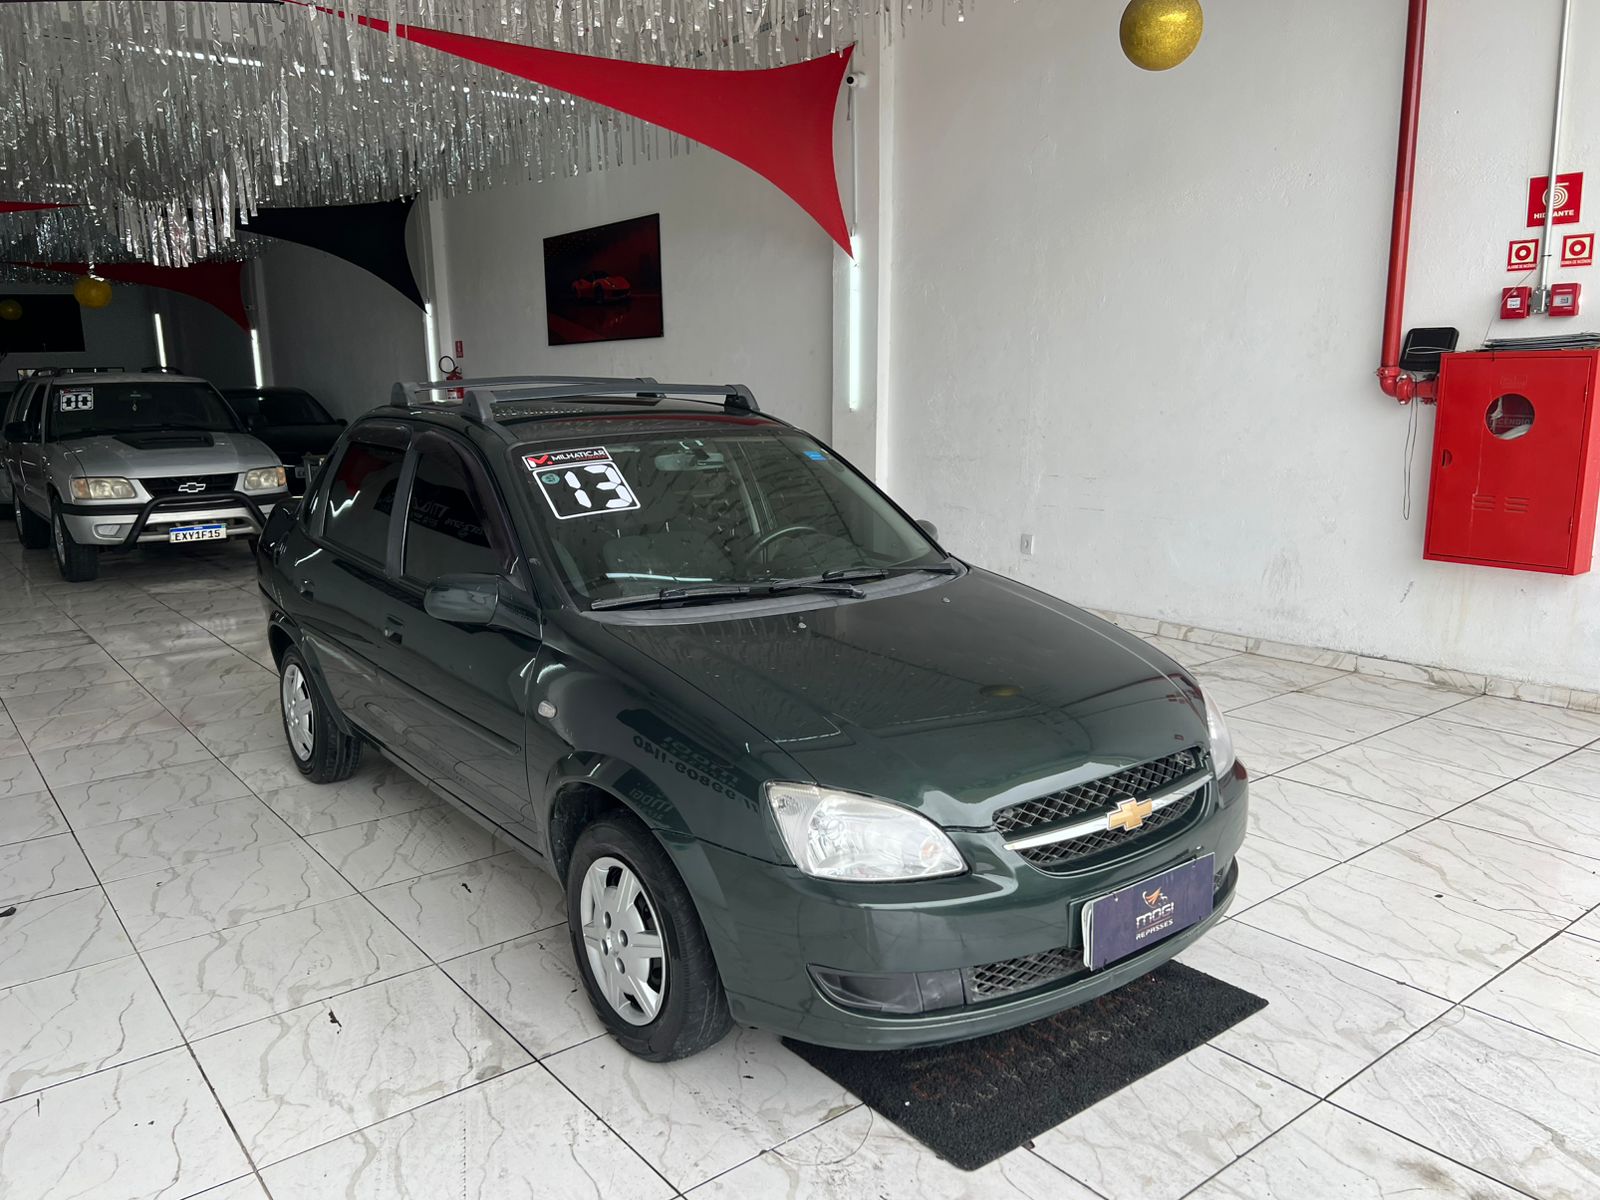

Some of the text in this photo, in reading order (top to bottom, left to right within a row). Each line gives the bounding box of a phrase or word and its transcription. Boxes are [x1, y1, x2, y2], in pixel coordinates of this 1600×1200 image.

[1533, 209, 1574, 219] HIDANTE
[564, 464, 633, 508] 13
[175, 529, 221, 541] EXY1F15
[1136, 918, 1174, 940] REPASSES
